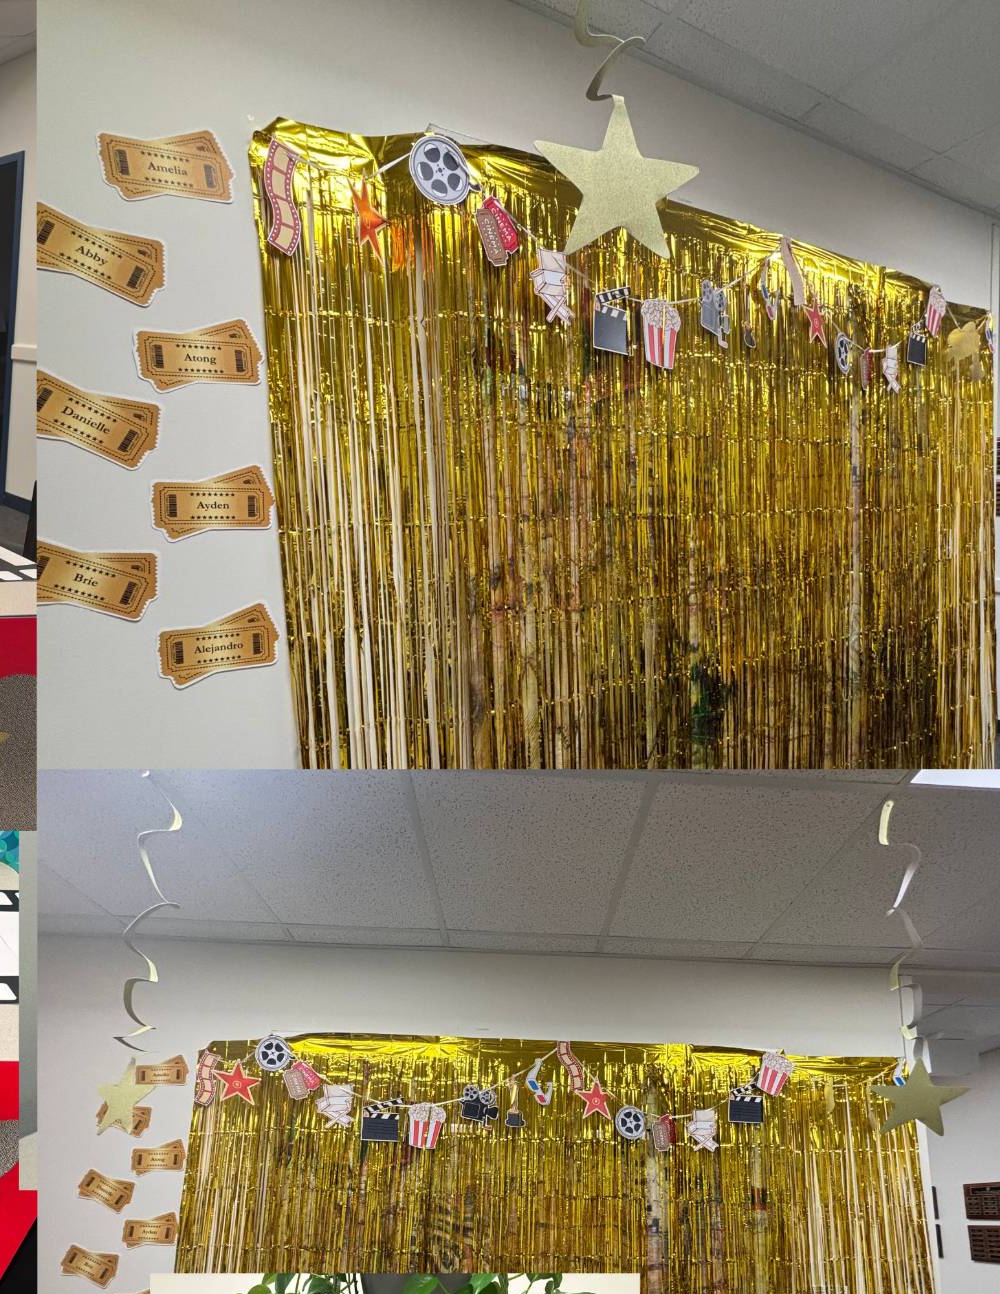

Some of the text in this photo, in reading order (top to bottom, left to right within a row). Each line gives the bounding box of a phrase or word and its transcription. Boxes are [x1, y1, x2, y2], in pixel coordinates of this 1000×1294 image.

[147, 160, 188, 176] Amelia
[74, 243, 109, 266] Abby
[184, 353, 217, 365] Atong
[61, 404, 111, 435] Danielle
[196, 500, 230, 512] Ayden
[73, 572, 98, 588] Brie
[194, 640, 244, 655] Alejandro
